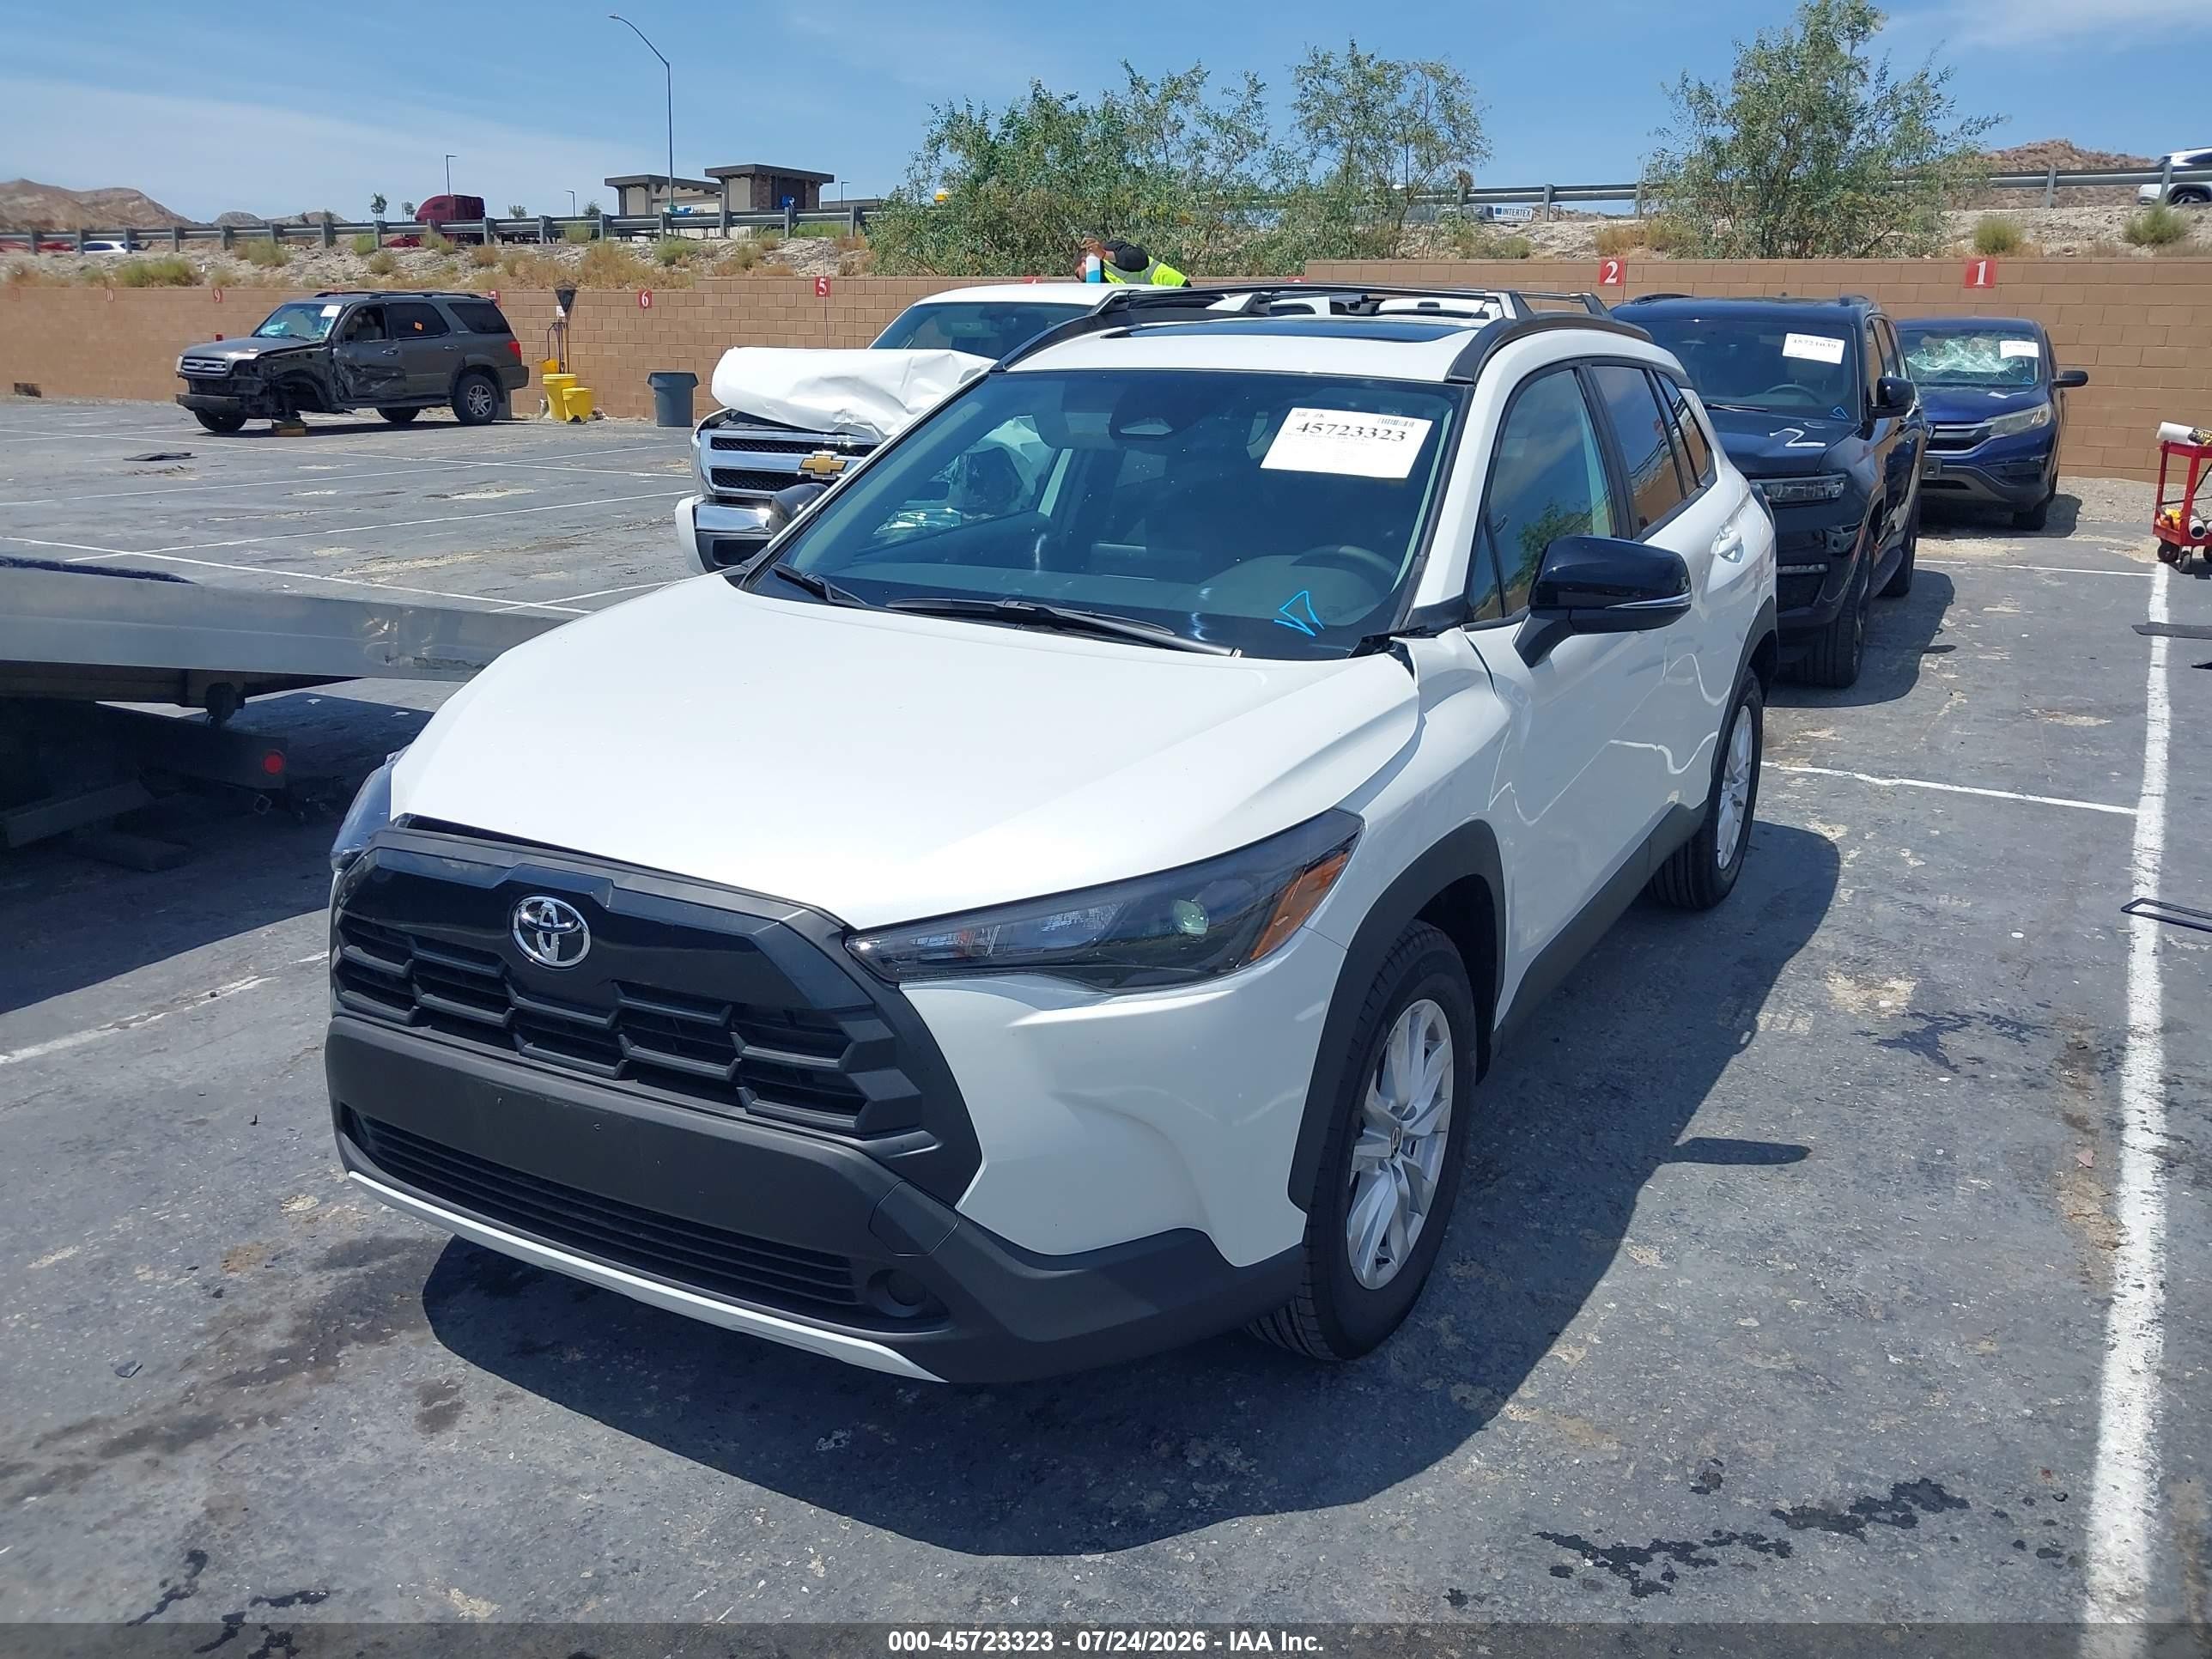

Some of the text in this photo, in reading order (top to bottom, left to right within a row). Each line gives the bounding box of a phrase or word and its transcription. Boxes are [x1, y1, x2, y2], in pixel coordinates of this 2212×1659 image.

[1503, 207, 1531, 217] INTERTEX
[1604, 261, 1619, 283] 2
[1972, 260, 1986, 285] 1
[817, 277, 827, 295] 5
[214, 289, 221, 302] 9
[641, 291, 649, 307] 6
[1296, 422, 1407, 442] 45723323
[1769, 428, 1826, 447] 2
